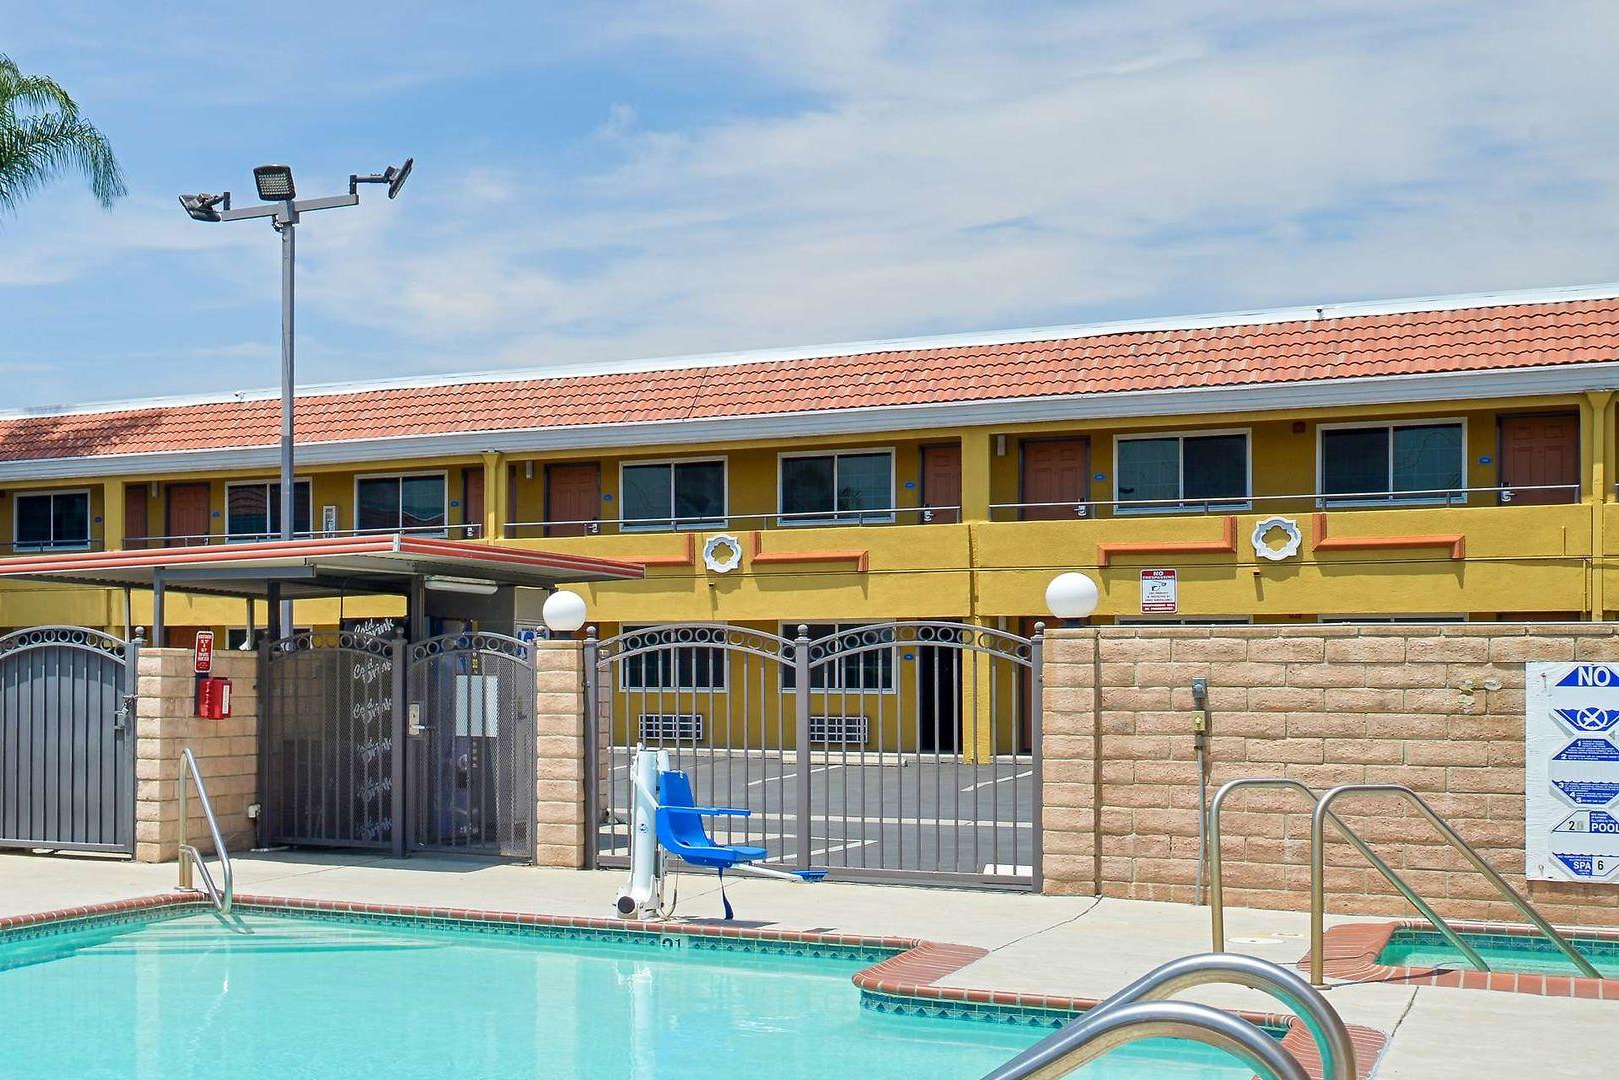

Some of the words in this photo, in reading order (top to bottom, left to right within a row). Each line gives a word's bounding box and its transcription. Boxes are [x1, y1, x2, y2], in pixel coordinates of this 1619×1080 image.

[1577, 666, 1611, 687] NO
[1573, 861, 1591, 870] SPA
[1597, 859, 1604, 871] 6
